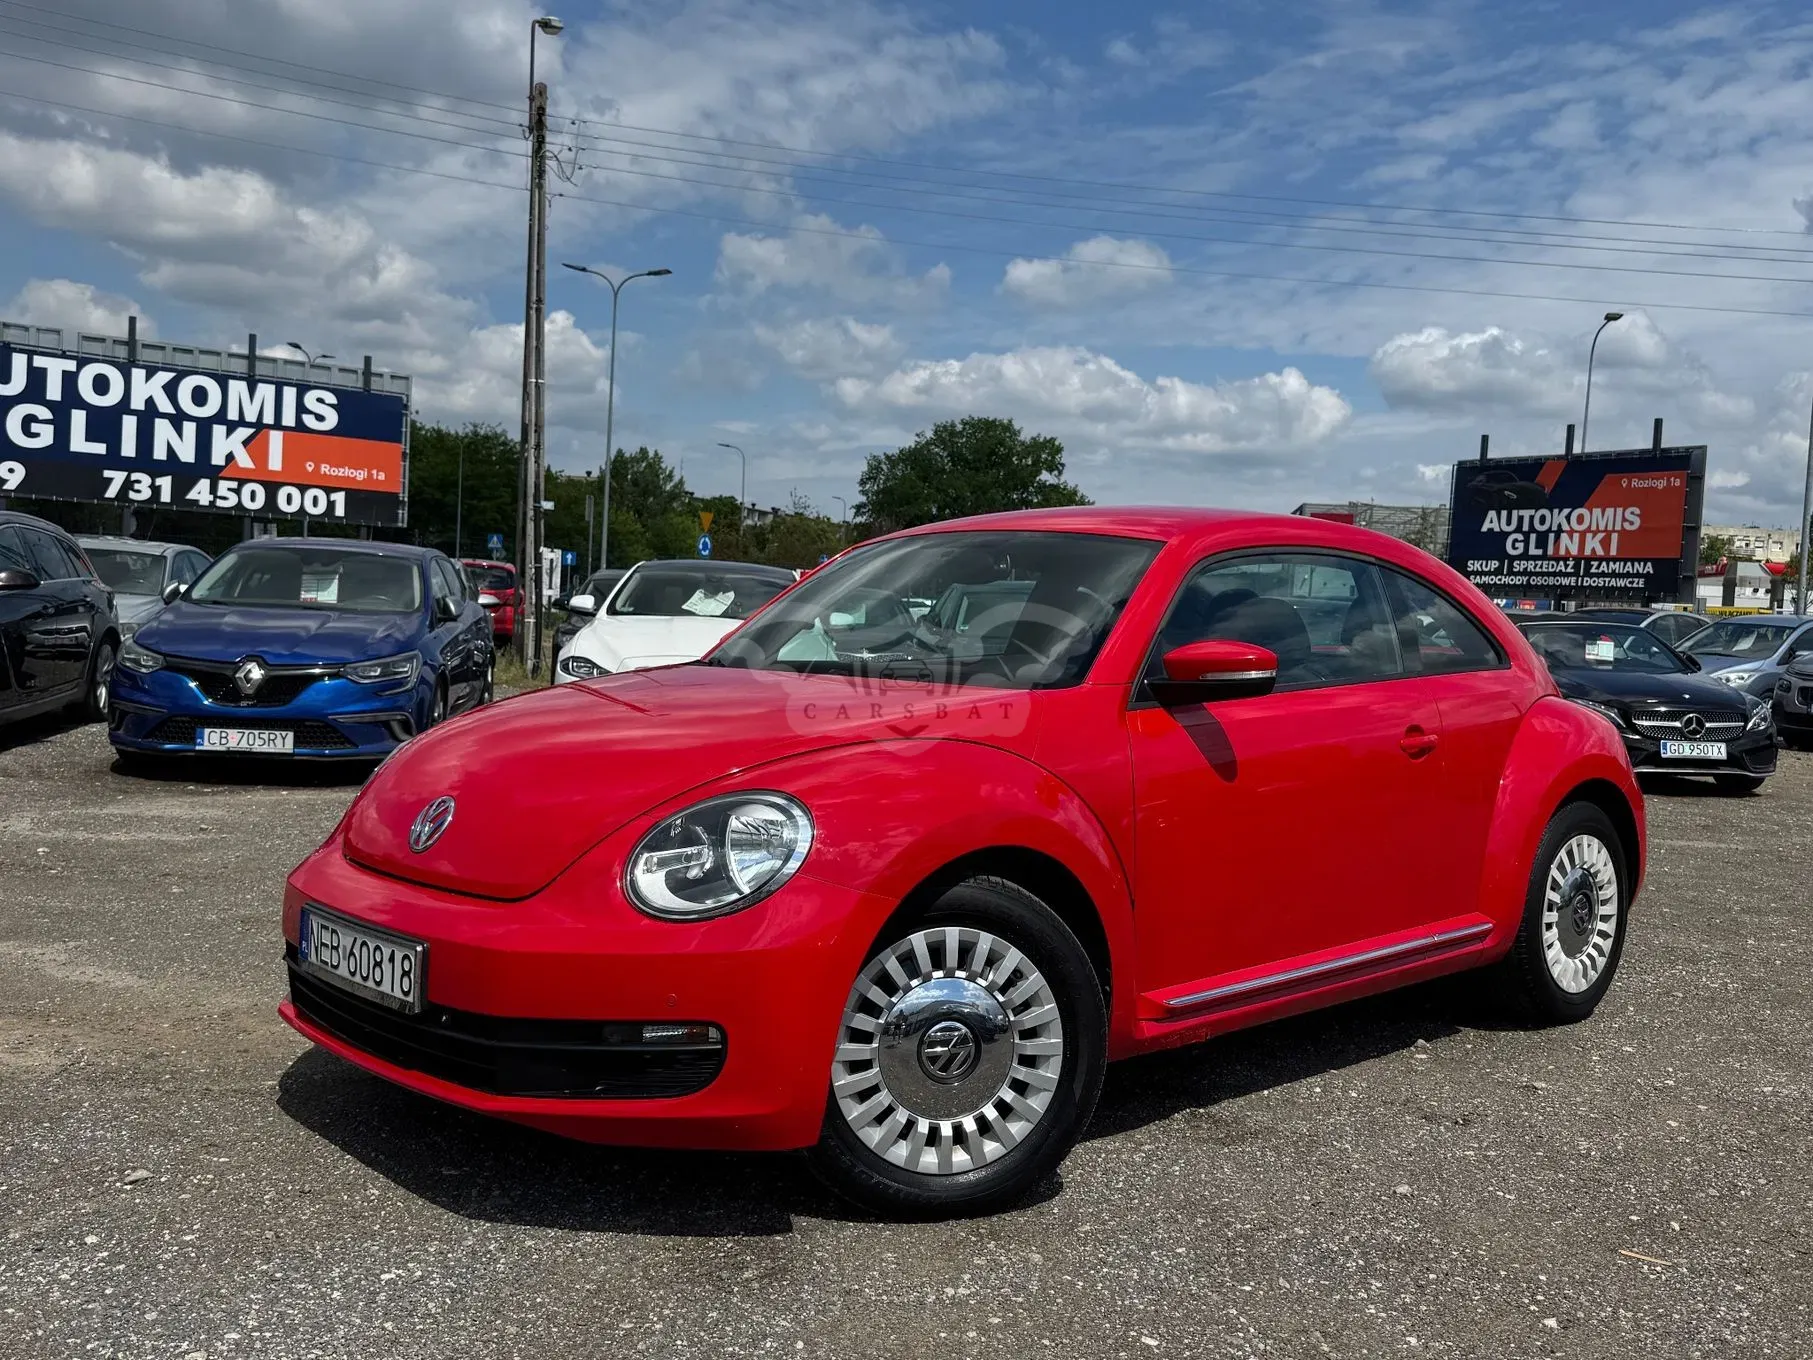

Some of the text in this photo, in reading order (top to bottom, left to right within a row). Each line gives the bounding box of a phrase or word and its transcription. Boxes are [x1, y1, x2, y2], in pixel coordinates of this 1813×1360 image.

[5, 403, 283, 471] GLINKI
[371, 468, 386, 481] 1a
[1670, 477, 1681, 487] 1a
[0, 460, 346, 517] 9 731 450 001
[1481, 507, 1641, 532] AUTOKOMIS
[1505, 532, 1619, 556] GLINKI
[1466, 557, 1654, 574] SKUP SPRZEDAŻ ZAMIANA
[1469, 575, 1645, 588] SAMOCHODY OSOBOWE I DOSTAWCZE
[207, 730, 229, 746] CB
[236, 731, 289, 748] 705RY
[1669, 743, 1723, 756] GD 950TX
[310, 918, 341, 970] NEB
[347, 936, 413, 997] 60818
